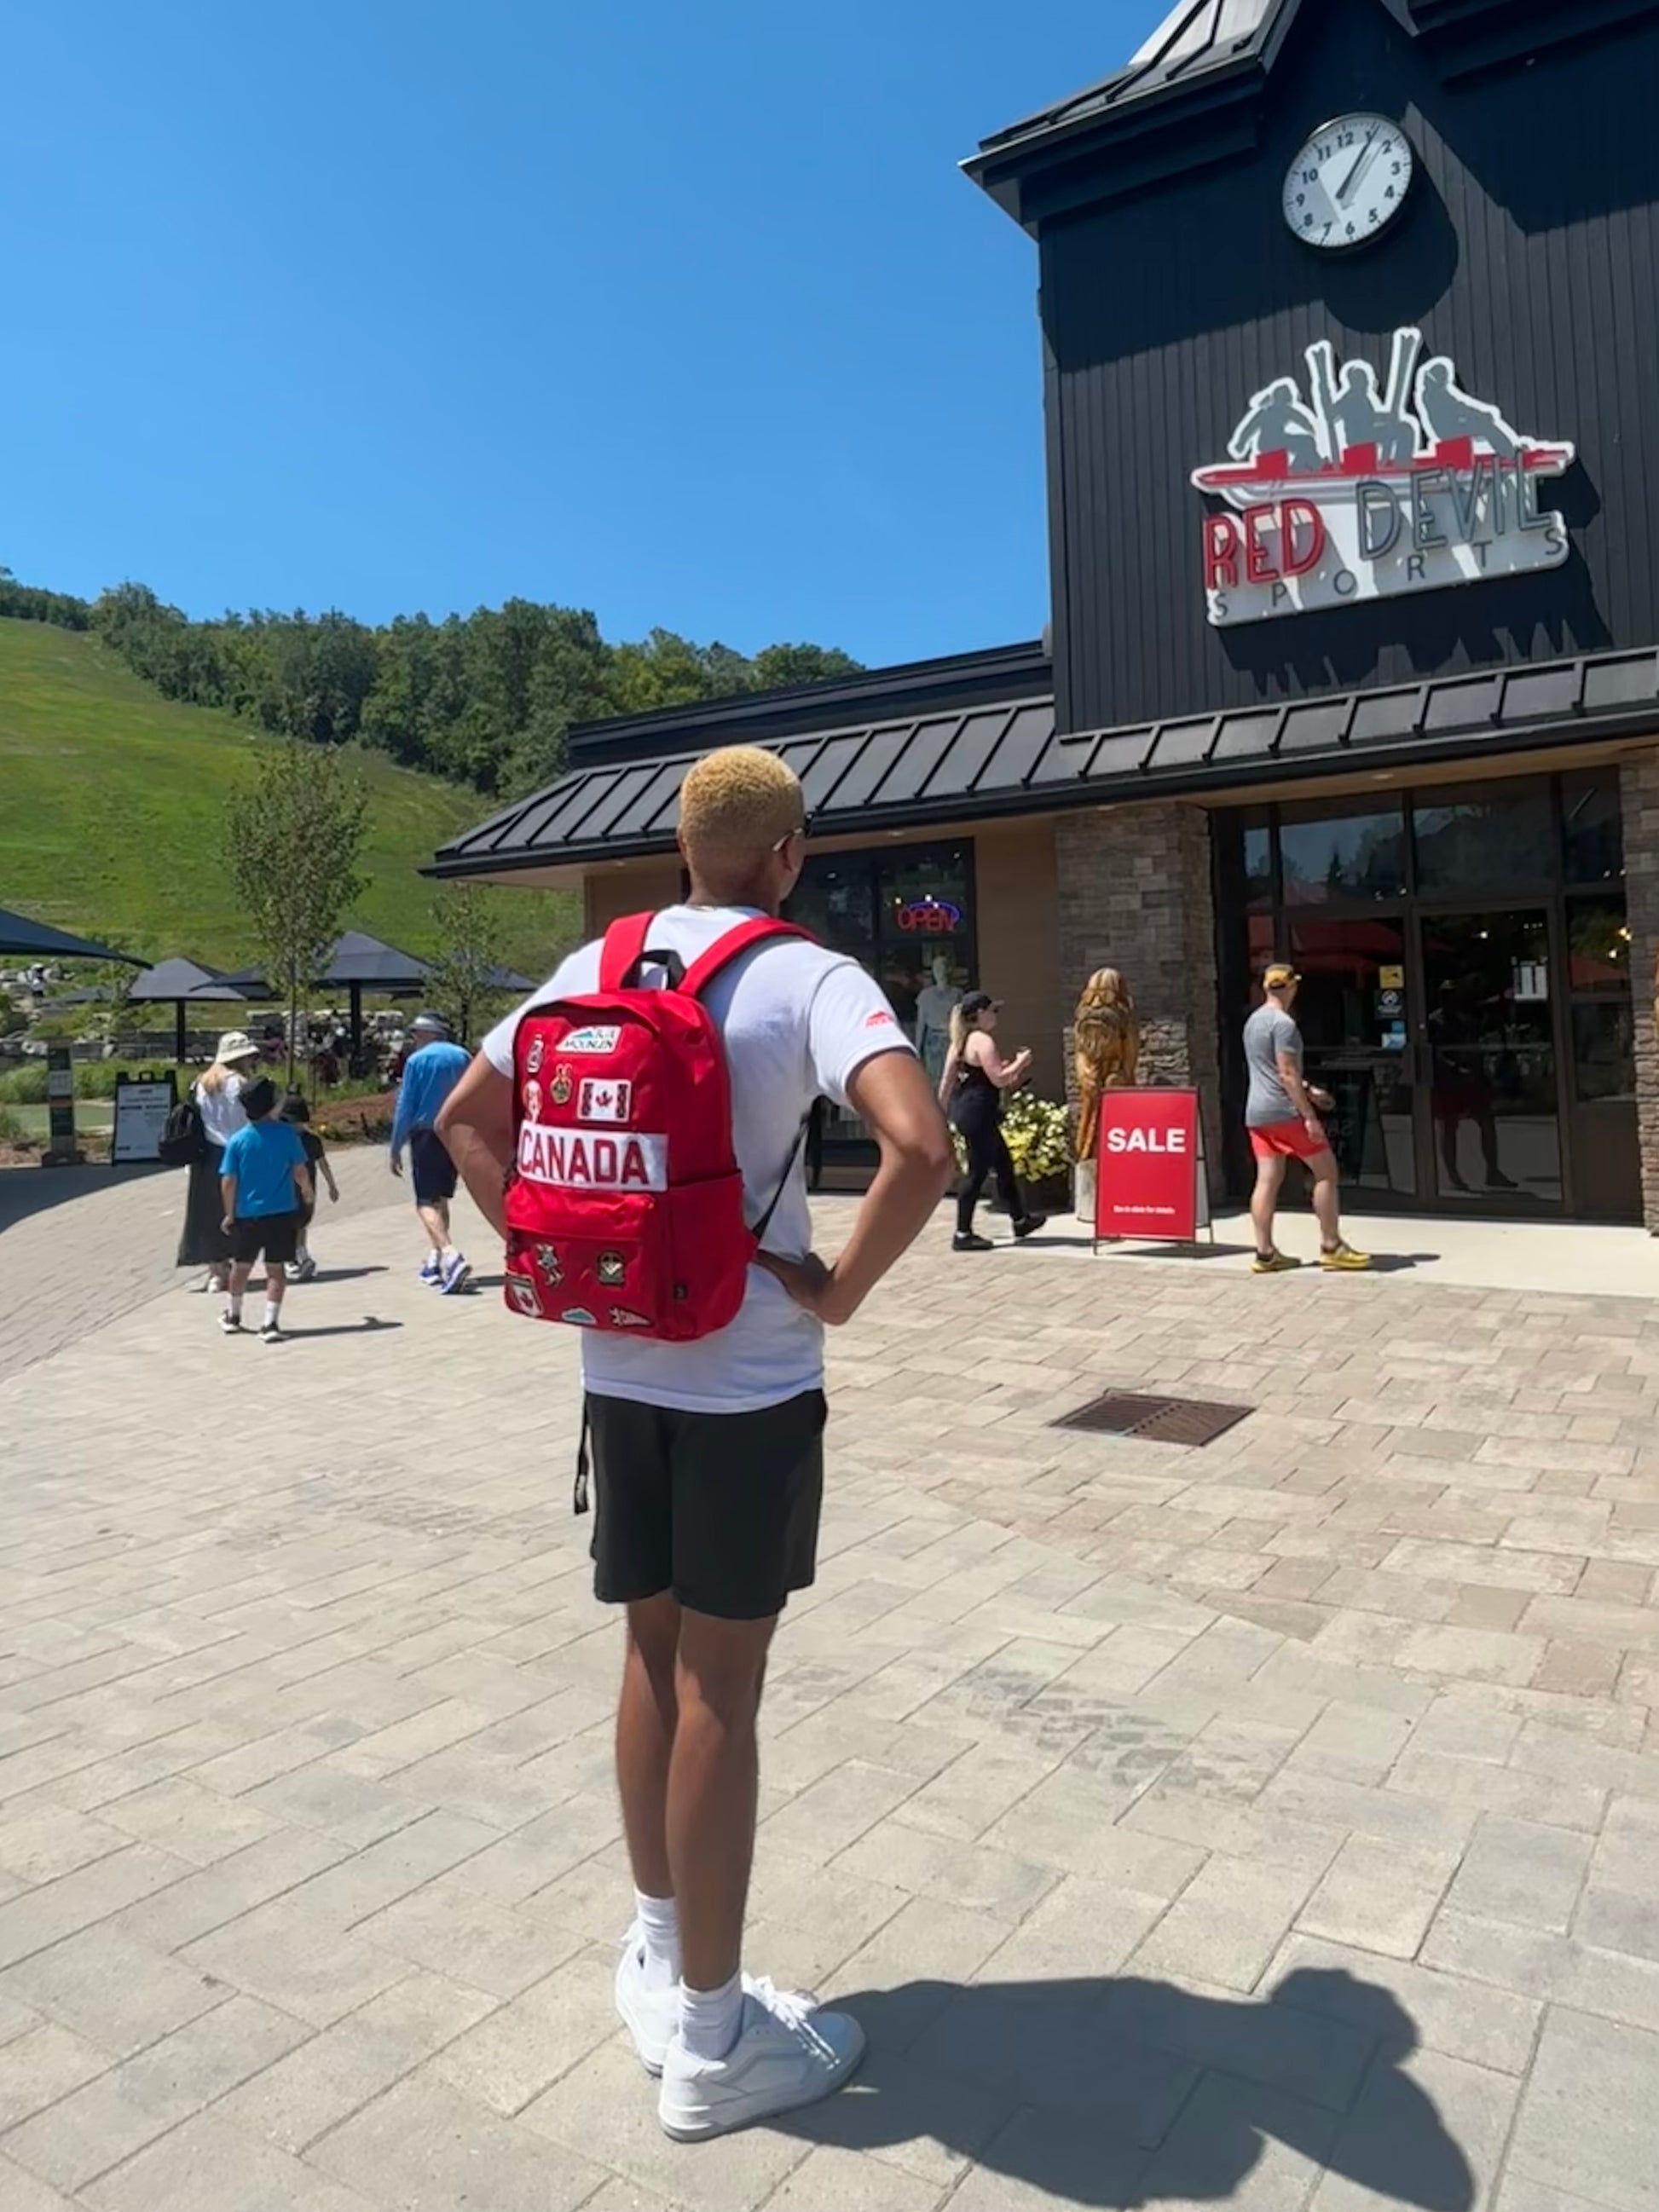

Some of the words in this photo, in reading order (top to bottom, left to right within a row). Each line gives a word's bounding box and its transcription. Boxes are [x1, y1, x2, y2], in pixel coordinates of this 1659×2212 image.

[1337, 131, 1354, 147] 12
[1318, 146, 1331, 160] 11
[1381, 140, 1391, 154] 2
[1391, 161, 1401, 175] 3
[1303, 168, 1319, 184] 10
[1384, 185, 1395, 199] 4
[1296, 193, 1305, 207] 9
[1304, 213, 1314, 227] 8
[1368, 208, 1378, 223] 5
[1323, 222, 1332, 236] 7
[1345, 221, 1356, 235] 6
[1203, 498, 1325, 590] RED
[1356, 448, 1552, 561] DEVIL
[1214, 528, 1567, 619] SPORTS
[897, 907, 954, 933] OPEN
[1107, 1127, 1186, 1152] SALE
[521, 1129, 650, 1185] CANADA
